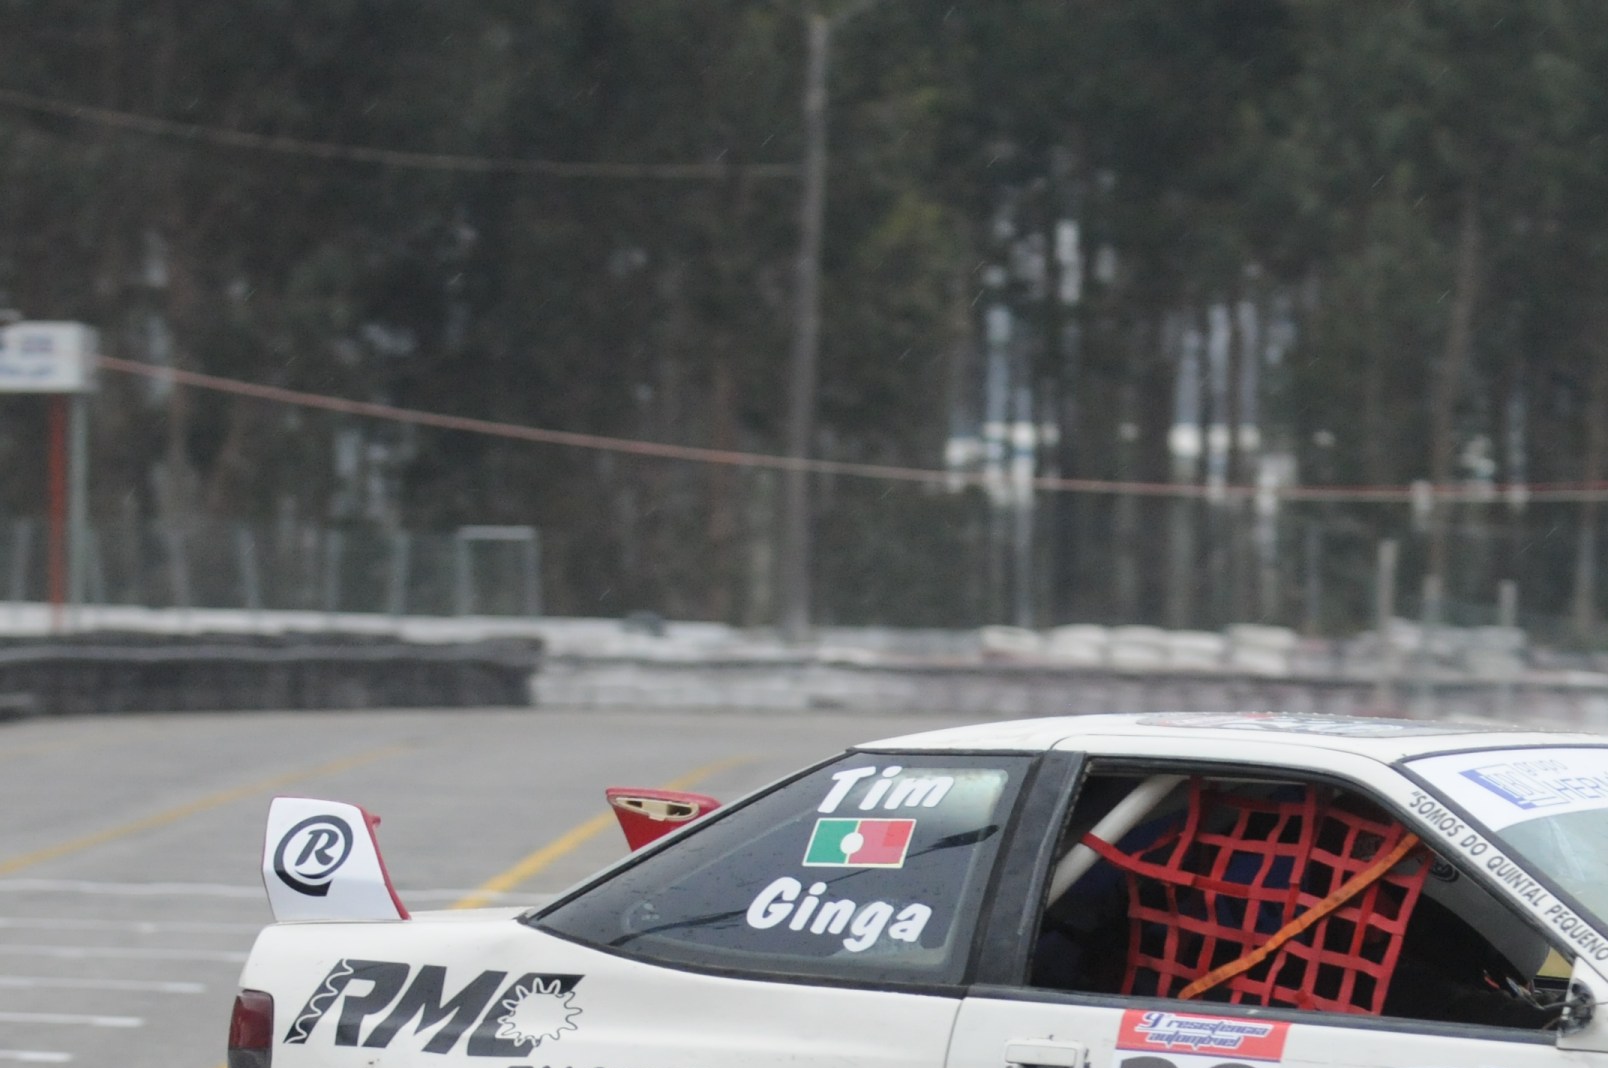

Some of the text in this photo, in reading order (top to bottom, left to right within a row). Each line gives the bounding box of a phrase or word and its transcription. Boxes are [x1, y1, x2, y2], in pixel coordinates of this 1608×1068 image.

[817, 765, 954, 813] Tim
[1460, 834, 1488, 856] DO
[1486, 855, 1545, 907] QUINTAL
[746, 877, 932, 952] Ginga
